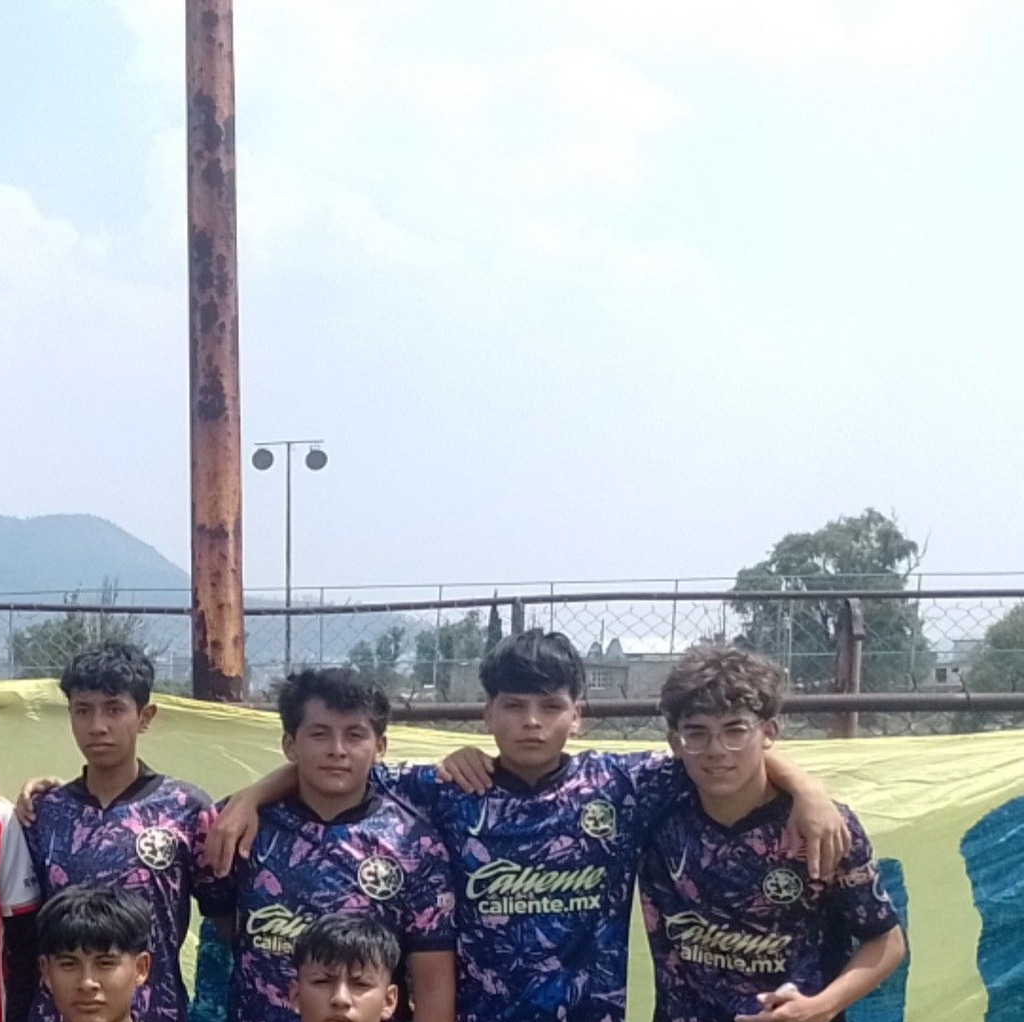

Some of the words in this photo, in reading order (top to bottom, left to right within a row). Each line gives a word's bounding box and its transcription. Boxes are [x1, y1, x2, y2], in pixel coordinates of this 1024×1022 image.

[466, 858, 606, 899] Caliente
[478, 894, 601, 914] caliente.mx
[663, 910, 793, 953] Caliente
[674, 943, 787, 973] aliente.mx
